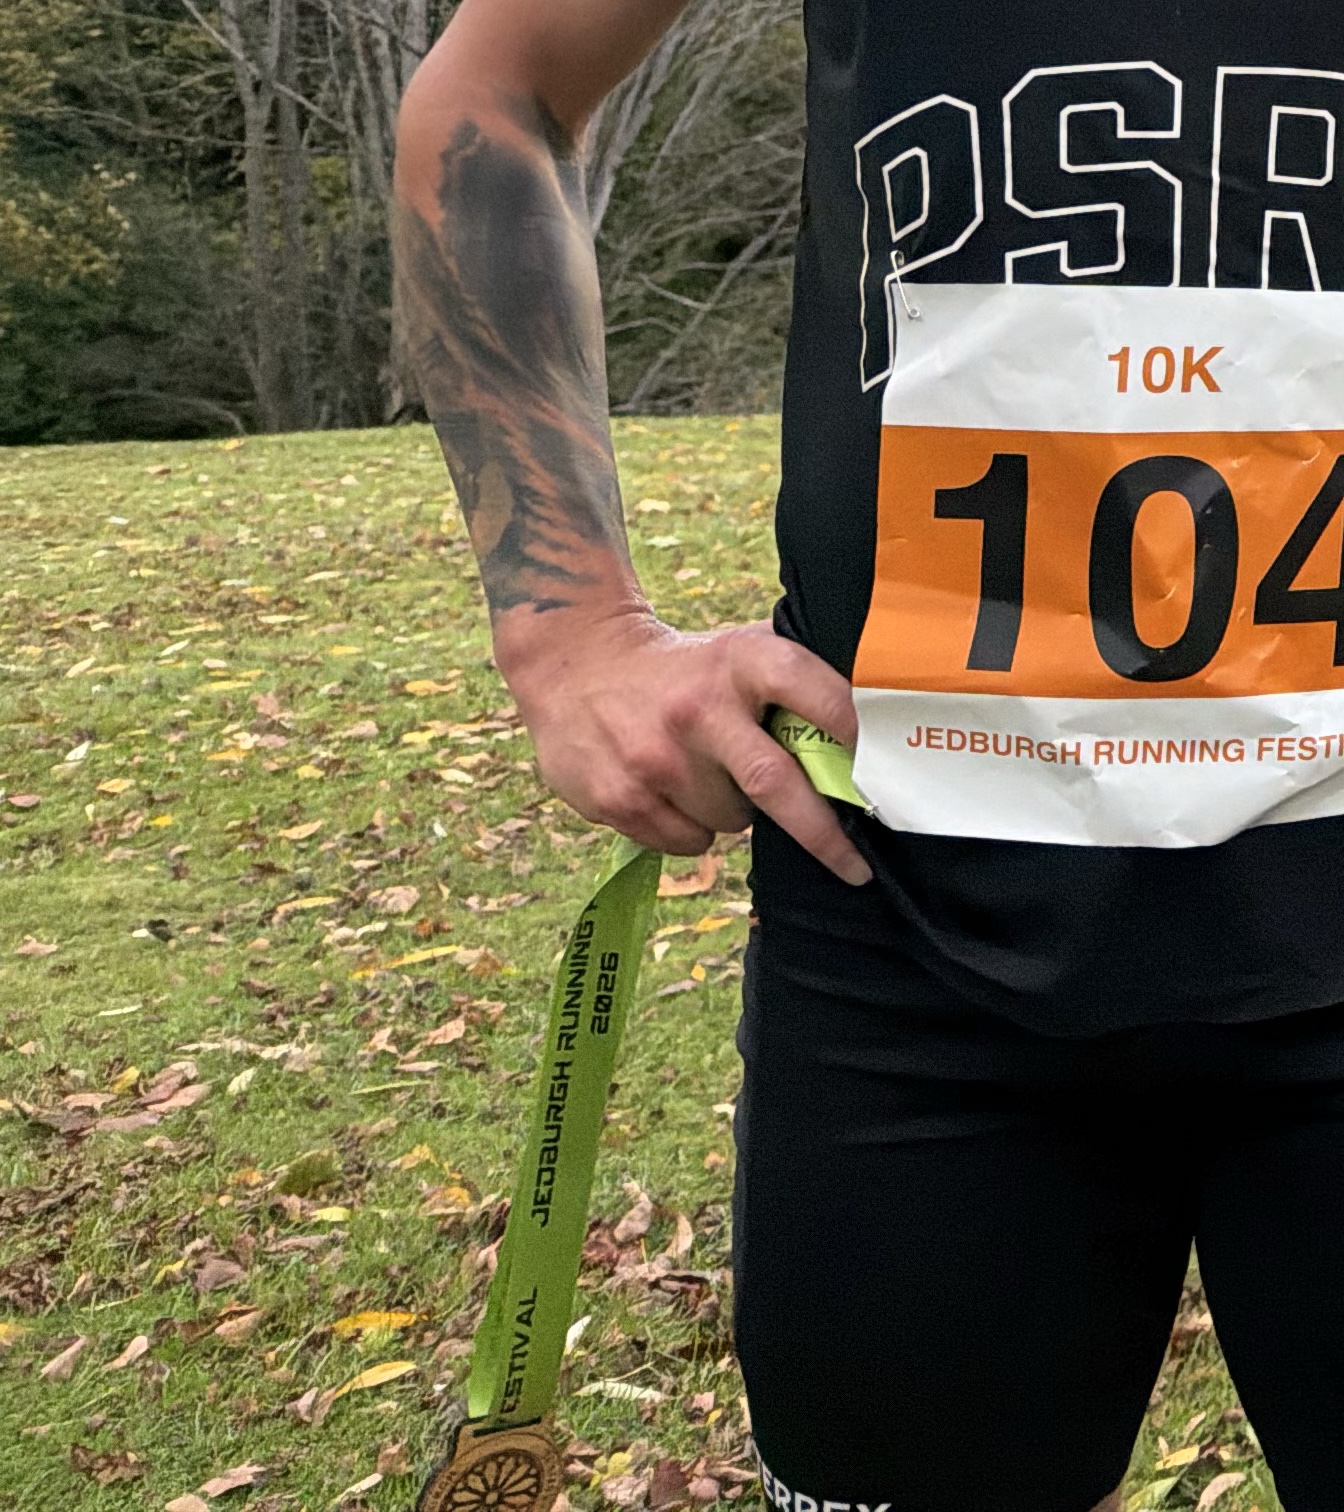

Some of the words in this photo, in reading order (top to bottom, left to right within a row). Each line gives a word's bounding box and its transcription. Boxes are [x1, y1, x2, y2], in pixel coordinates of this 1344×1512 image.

[1108, 345, 1224, 394] 10K
[907, 725, 1081, 766] JEDBURGH
[1094, 738, 1245, 766] RUNNING
[590, 951, 619, 1036] 2026
[531, 1061, 573, 1228] JEDBURGH
[556, 920, 594, 1051] RUNNING
[502, 1287, 537, 1414] ESTIVAL
